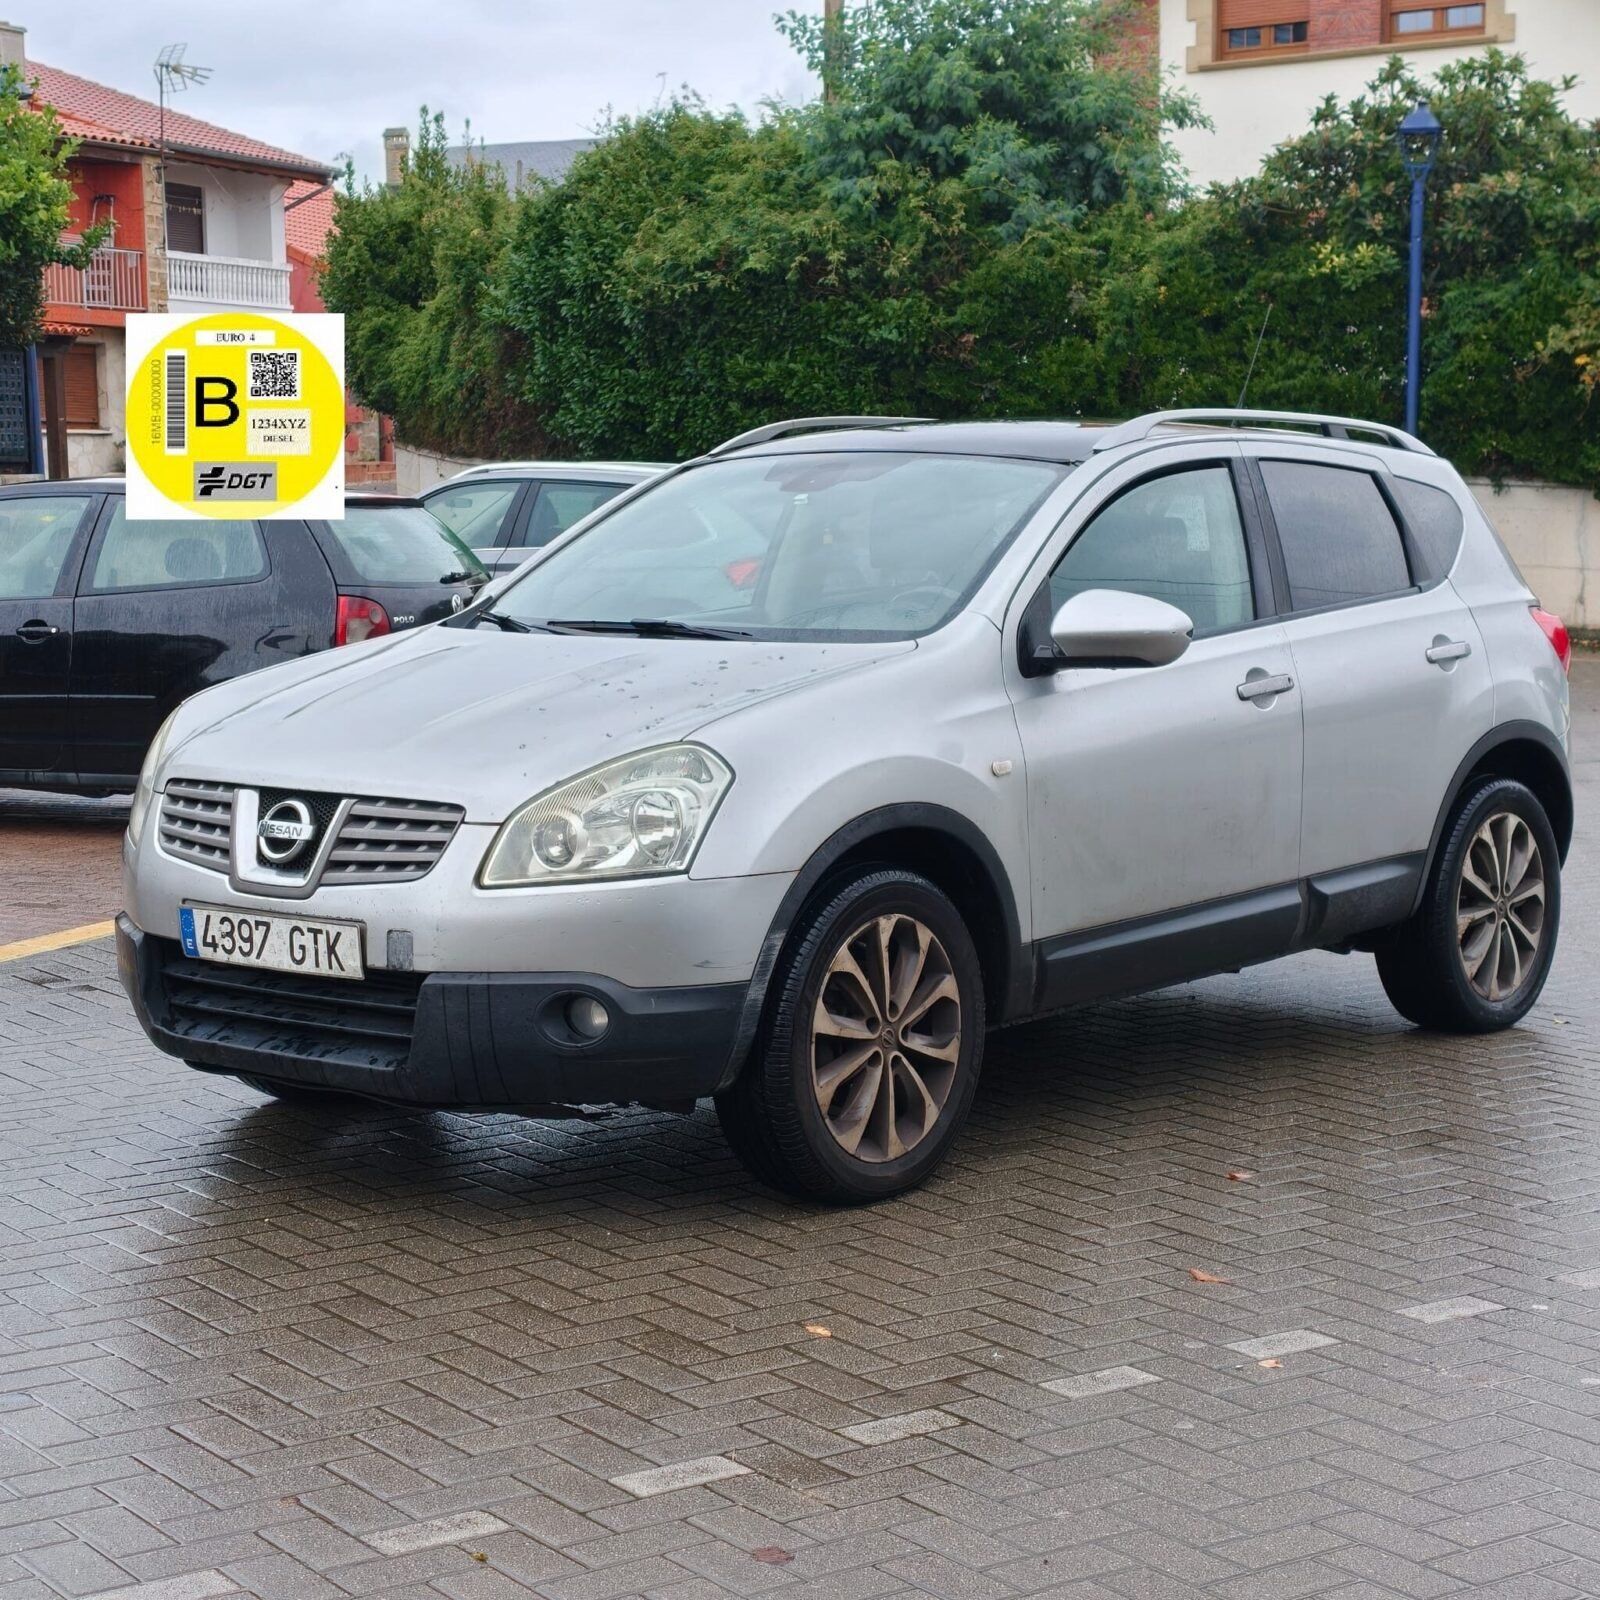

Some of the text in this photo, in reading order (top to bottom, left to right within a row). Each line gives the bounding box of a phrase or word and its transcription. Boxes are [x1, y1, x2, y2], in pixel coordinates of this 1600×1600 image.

[393, 616, 415, 624] POLO
[260, 821, 302, 837] NISSAN
[186, 939, 194, 949] E
[202, 914, 345, 972] 4397 GTK
